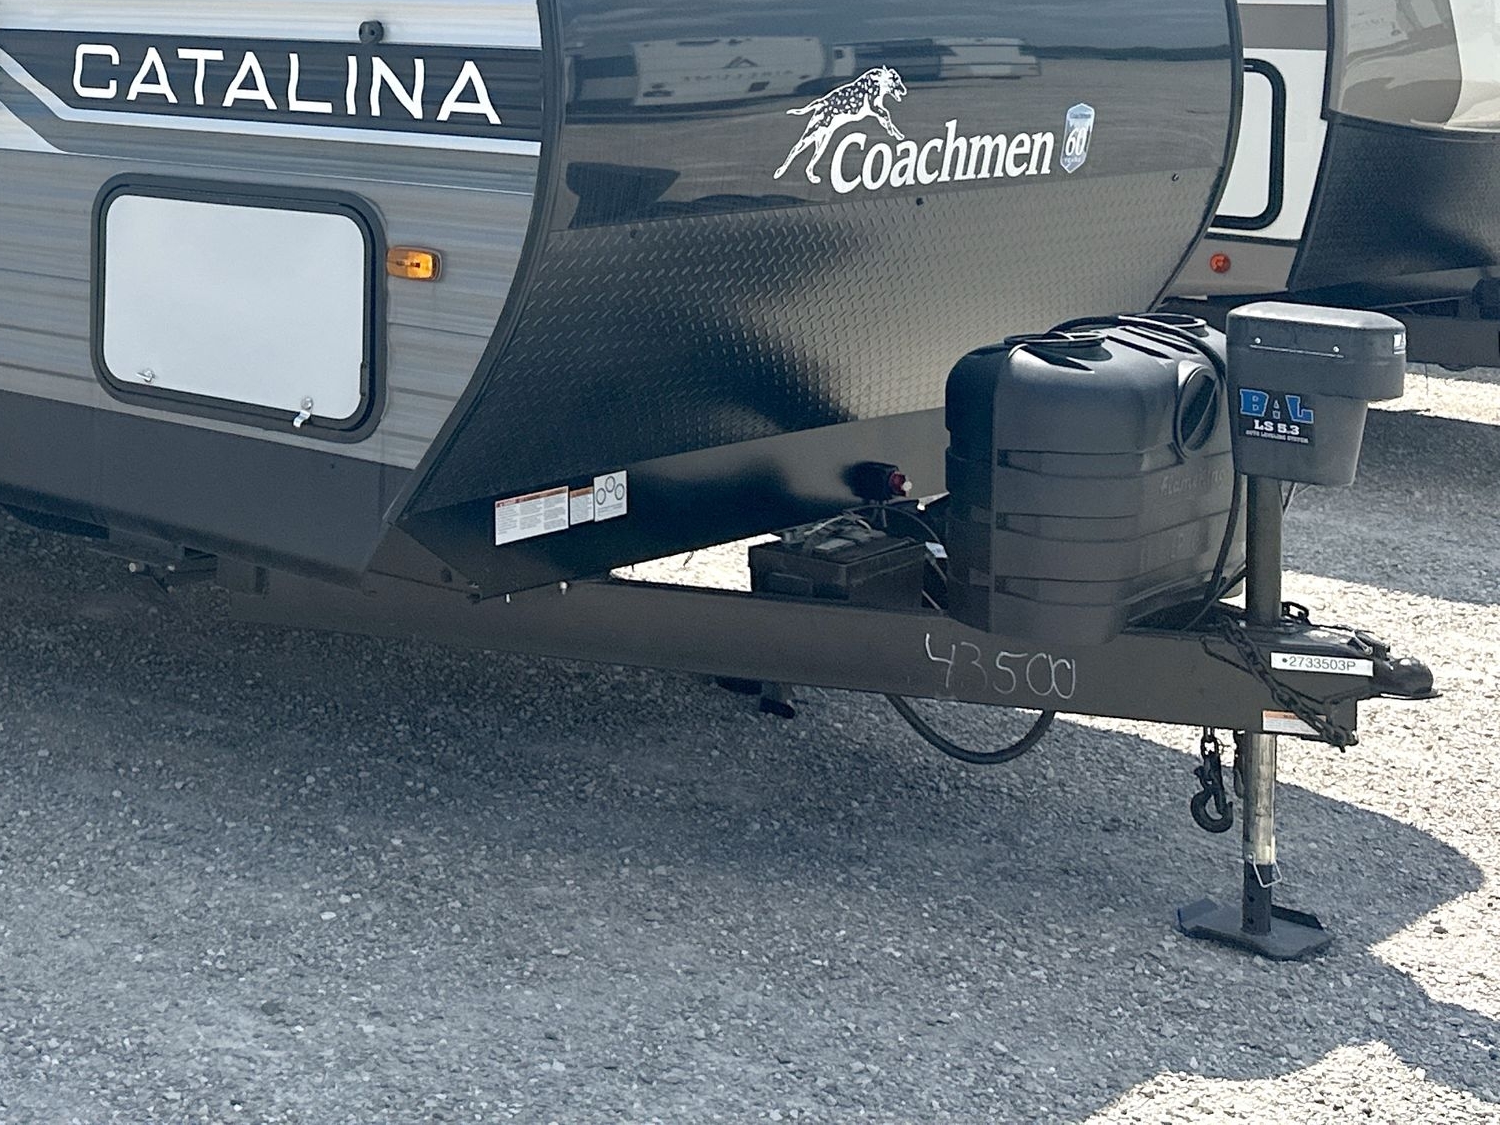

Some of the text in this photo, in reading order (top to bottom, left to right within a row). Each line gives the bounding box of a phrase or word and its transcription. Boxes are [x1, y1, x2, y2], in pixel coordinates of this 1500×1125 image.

[72, 43, 502, 125] CATALINA
[830, 118, 1055, 194] Coachmen
[1065, 127, 1088, 156] 60
[1253, 419, 1300, 436] LS 5.3
[924, 632, 1077, 700] 43500
